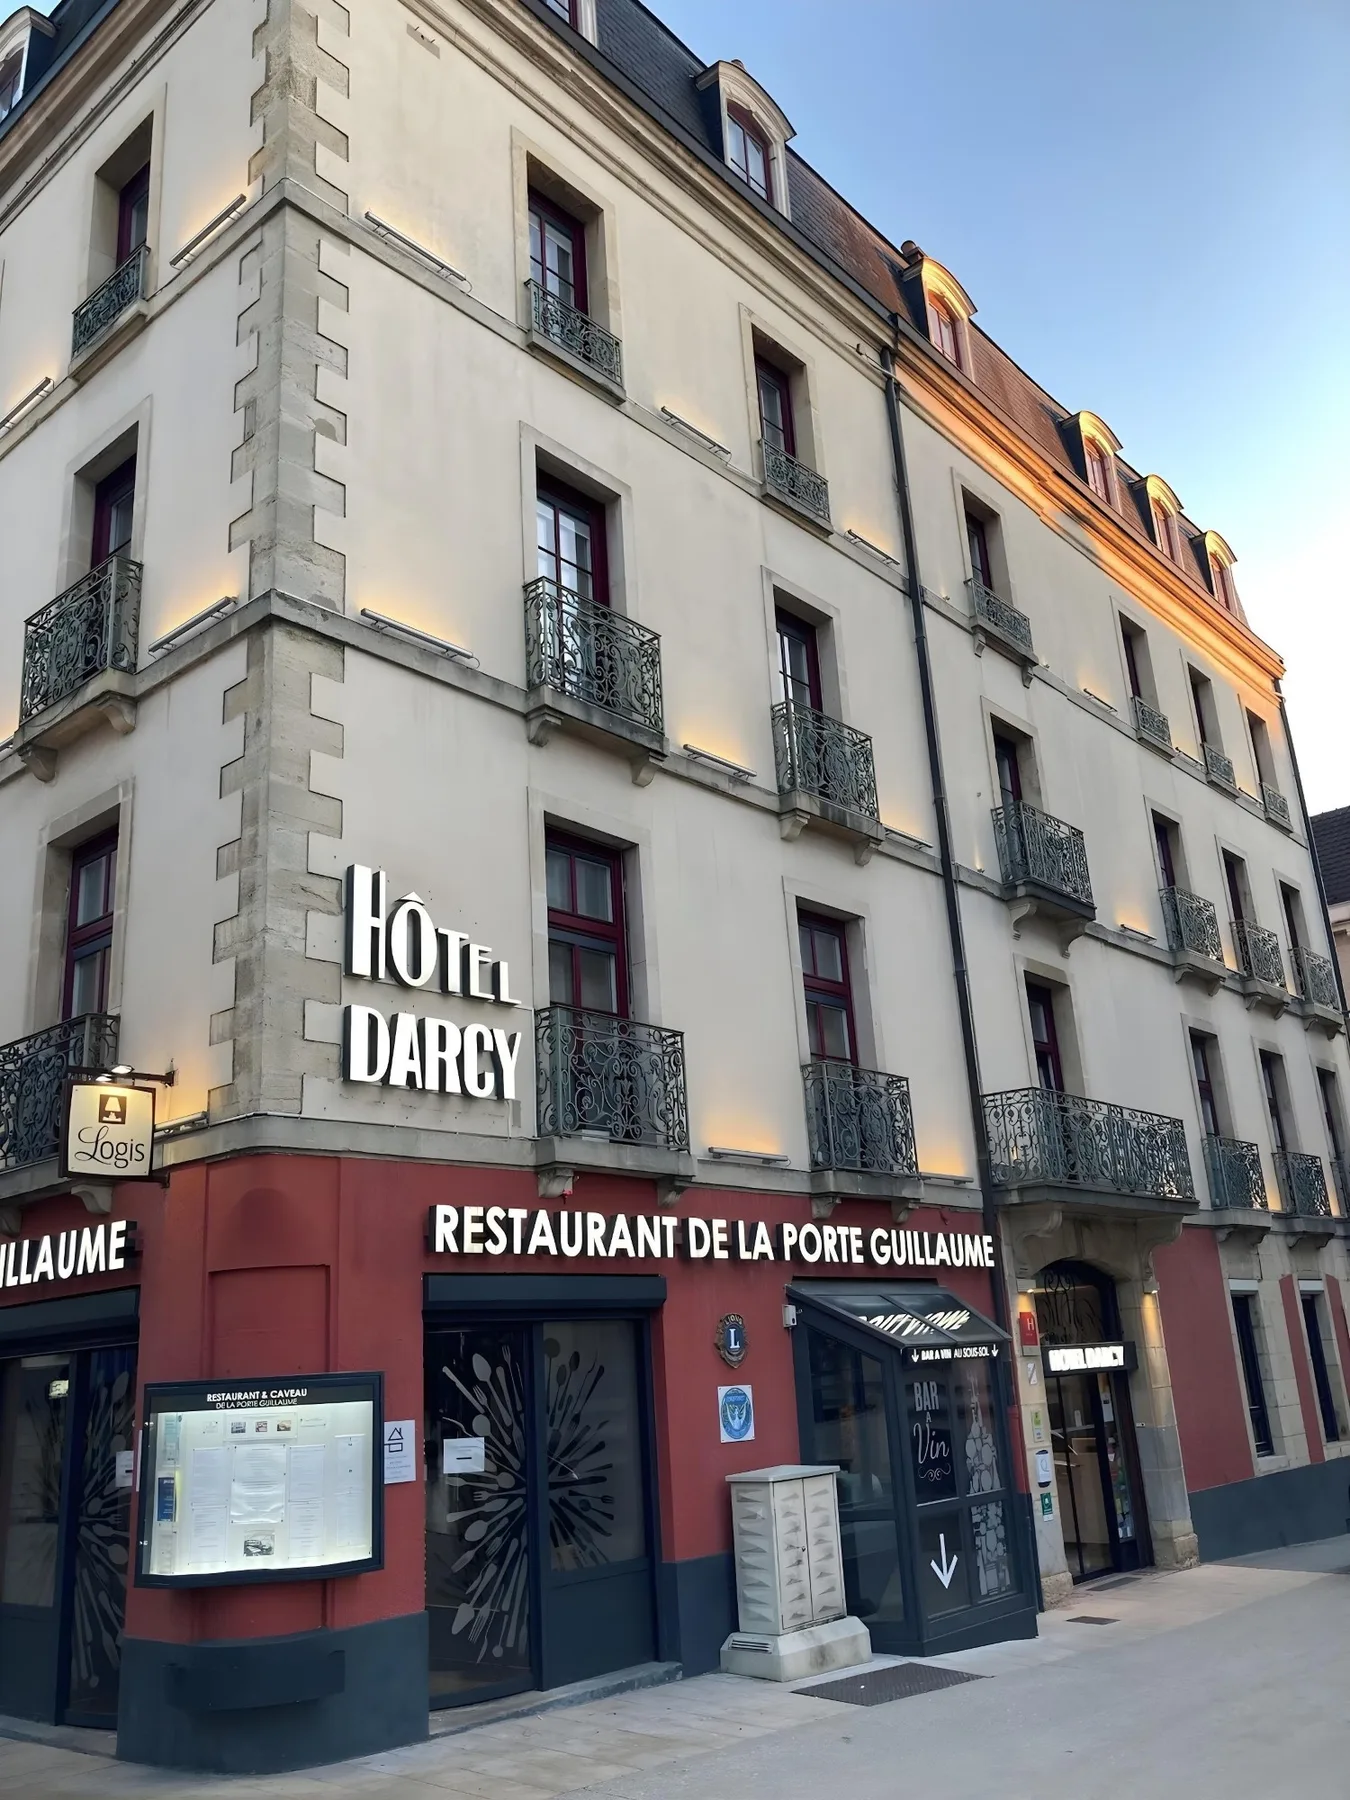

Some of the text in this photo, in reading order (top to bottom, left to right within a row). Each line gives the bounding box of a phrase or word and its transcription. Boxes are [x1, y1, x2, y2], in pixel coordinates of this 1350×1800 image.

[349, 864, 521, 1004] HÔTEL
[348, 1004, 521, 1099] DARCY
[74, 1125, 145, 1168] Logis
[434, 1204, 995, 1267] RESTAURANT DE LA PORTE GUILLAUME
[1027, 1317, 1035, 1331] H
[729, 1328, 740, 1349] L
[921, 1350, 934, 1360] BAR
[954, 1348, 962, 1358] AU
[963, 1346, 990, 1358] SOUS-SOL
[206, 1388, 307, 1402] RESTAURANT & CAVEAU
[236, 1400, 258, 1408] PORTE
[259, 1398, 298, 1407] GUILLAUME
[913, 1381, 939, 1411] BAR
[926, 1411, 932, 1422] A
[913, 1422, 949, 1464] Vin
